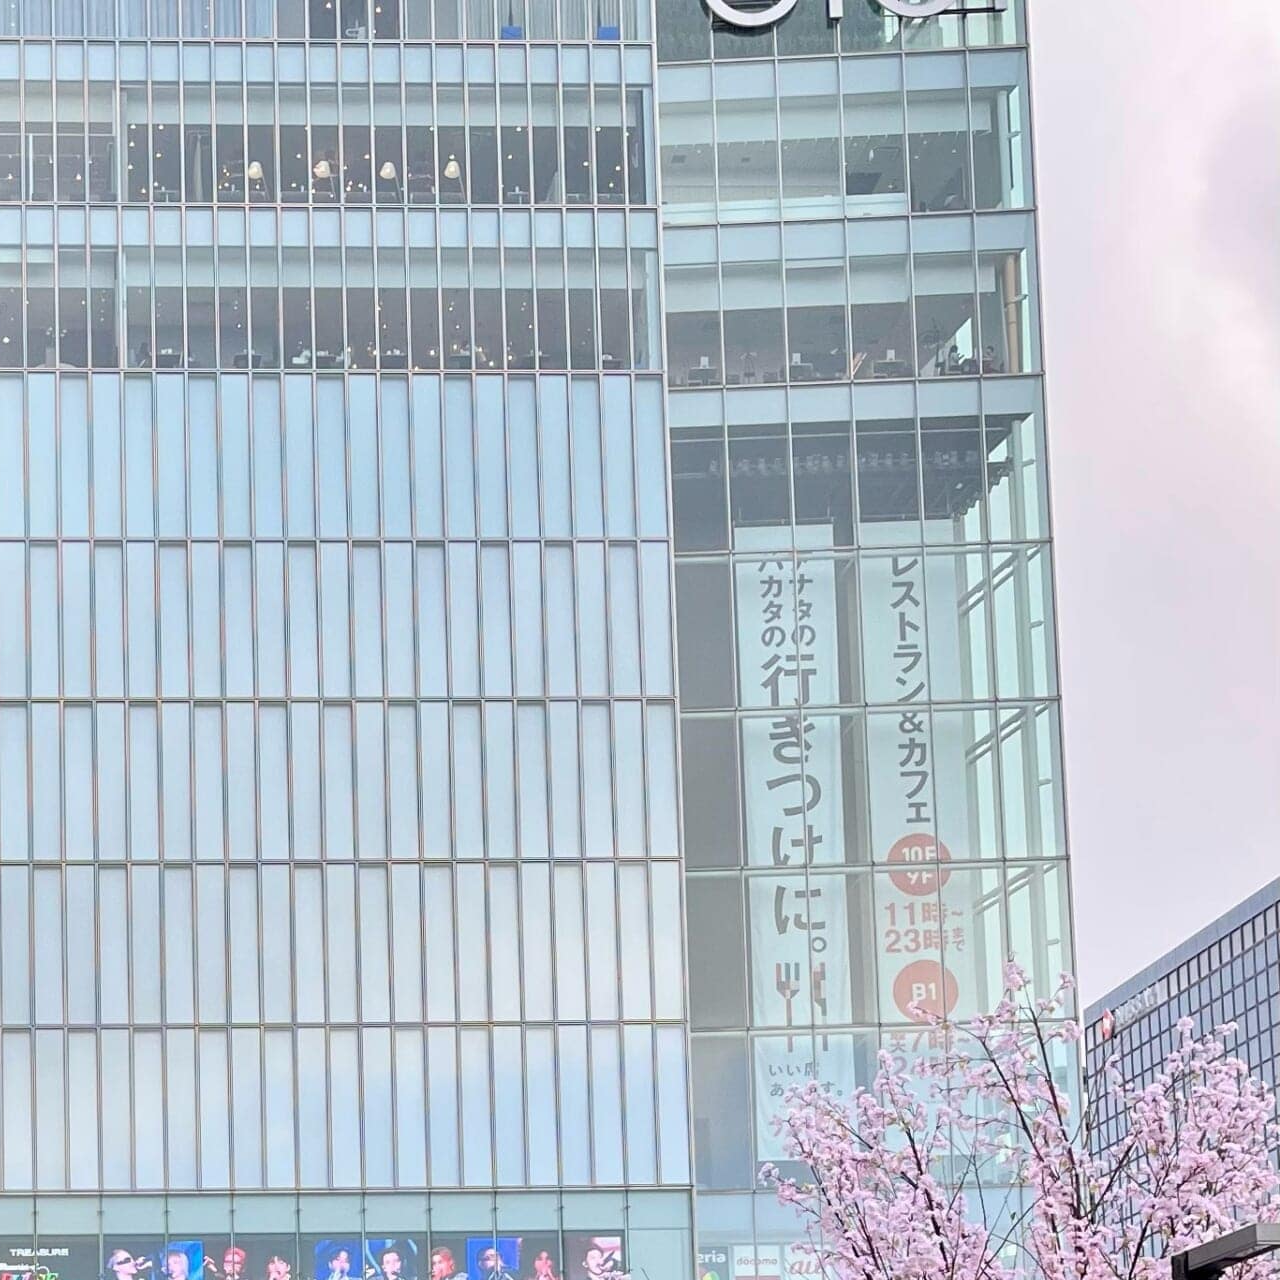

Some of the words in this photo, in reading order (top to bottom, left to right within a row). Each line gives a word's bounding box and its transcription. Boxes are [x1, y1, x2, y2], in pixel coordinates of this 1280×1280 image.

[789, 557, 816, 646] ナタの
[912, 983, 937, 1001] B1
